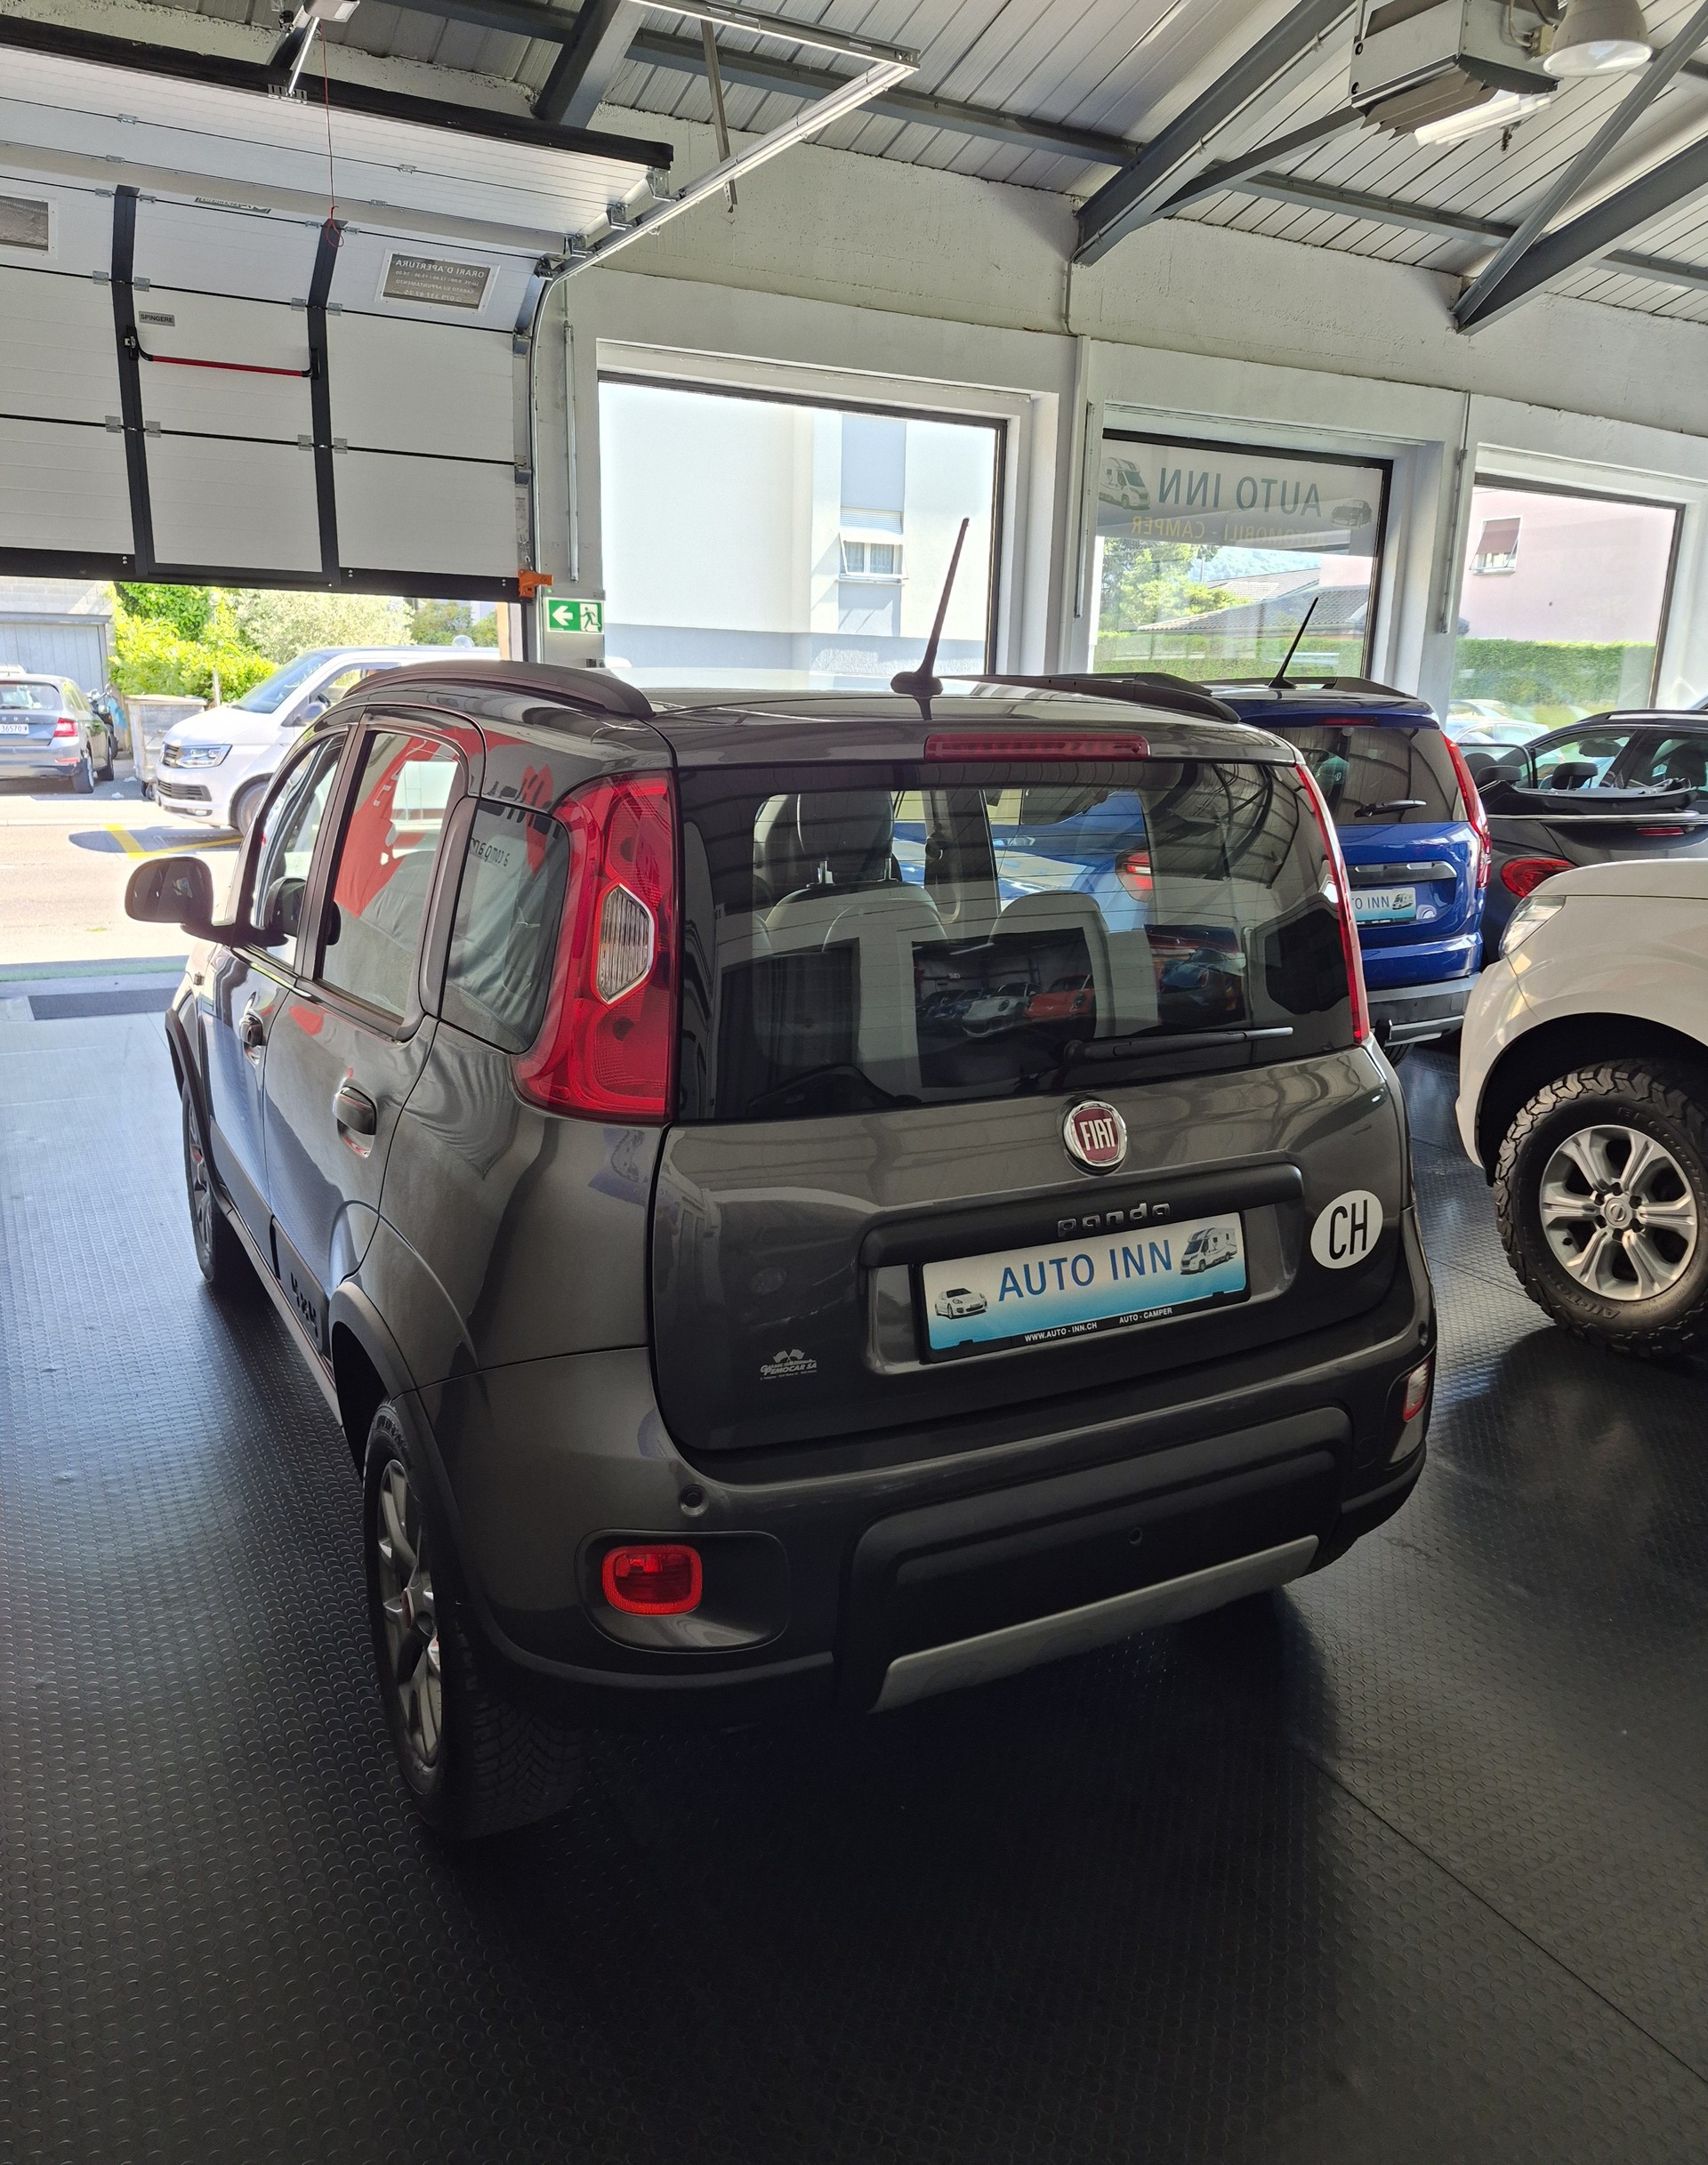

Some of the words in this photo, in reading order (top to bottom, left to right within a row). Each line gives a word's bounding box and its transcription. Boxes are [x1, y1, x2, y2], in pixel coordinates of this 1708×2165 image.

[141, 313, 173, 324] SPINGERE
[1367, 896, 1390, 908] INN
[1079, 1118, 1116, 1151] FIAT
[1057, 1202, 1171, 1237] panda
[1329, 1205, 1368, 1260] CH
[998, 1253, 1095, 1301] AUTO
[1109, 1239, 1172, 1280] INN
[1119, 1313, 1139, 1324] AUTO
[1143, 1308, 1172, 1319] CAMPER
